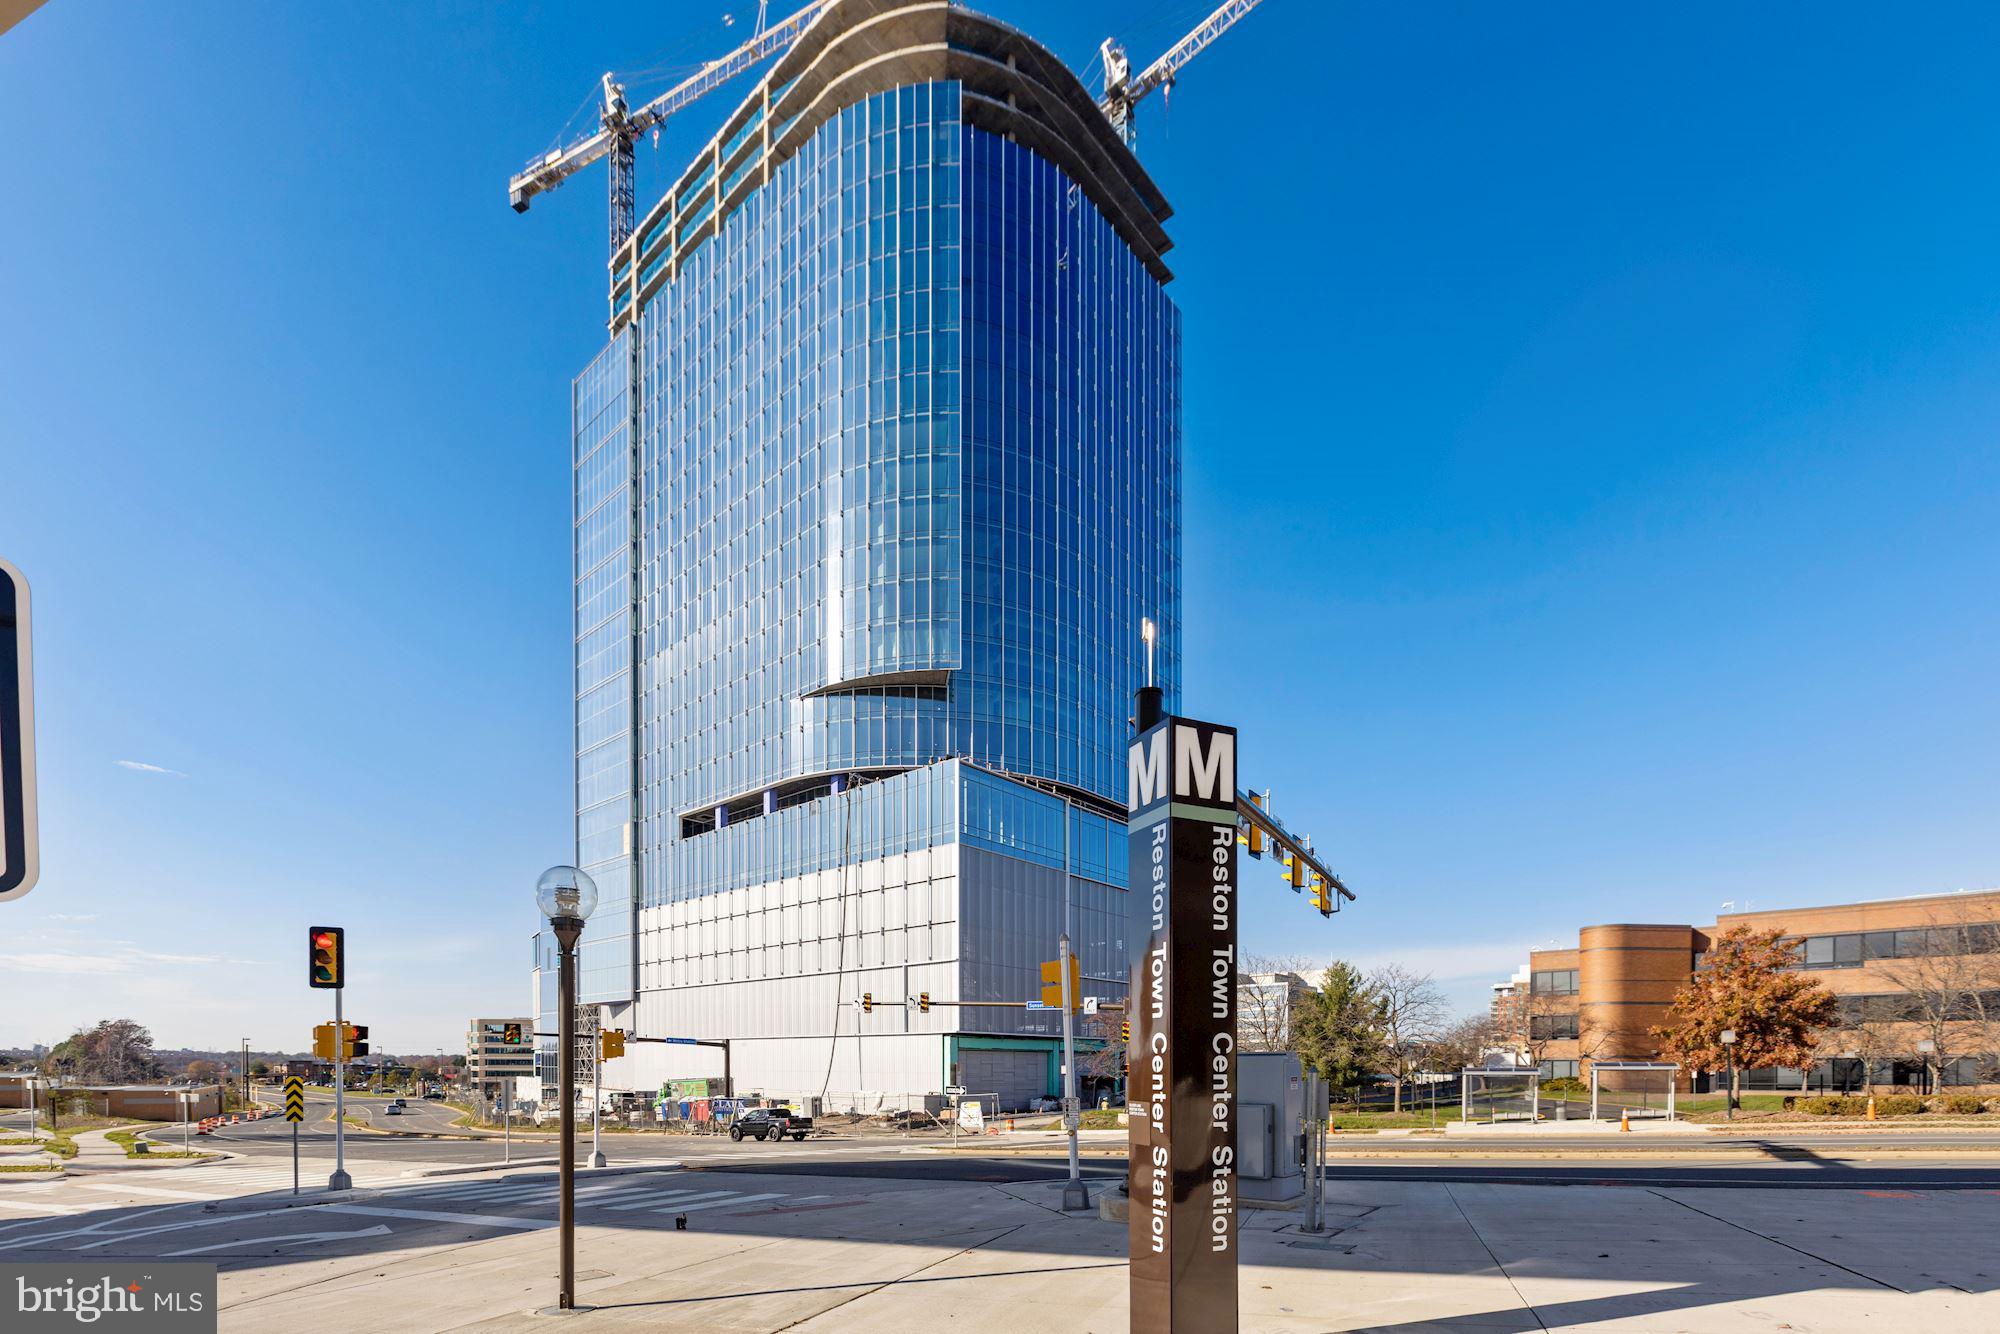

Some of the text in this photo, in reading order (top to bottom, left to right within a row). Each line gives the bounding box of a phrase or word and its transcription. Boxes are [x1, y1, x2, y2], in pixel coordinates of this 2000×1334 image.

[1128, 727, 1167, 812] M
[1175, 724, 1234, 802] M
[1152, 822, 1167, 1253] Reston Town Center Station
[1212, 825, 1233, 1252] Reston Town Center Station
